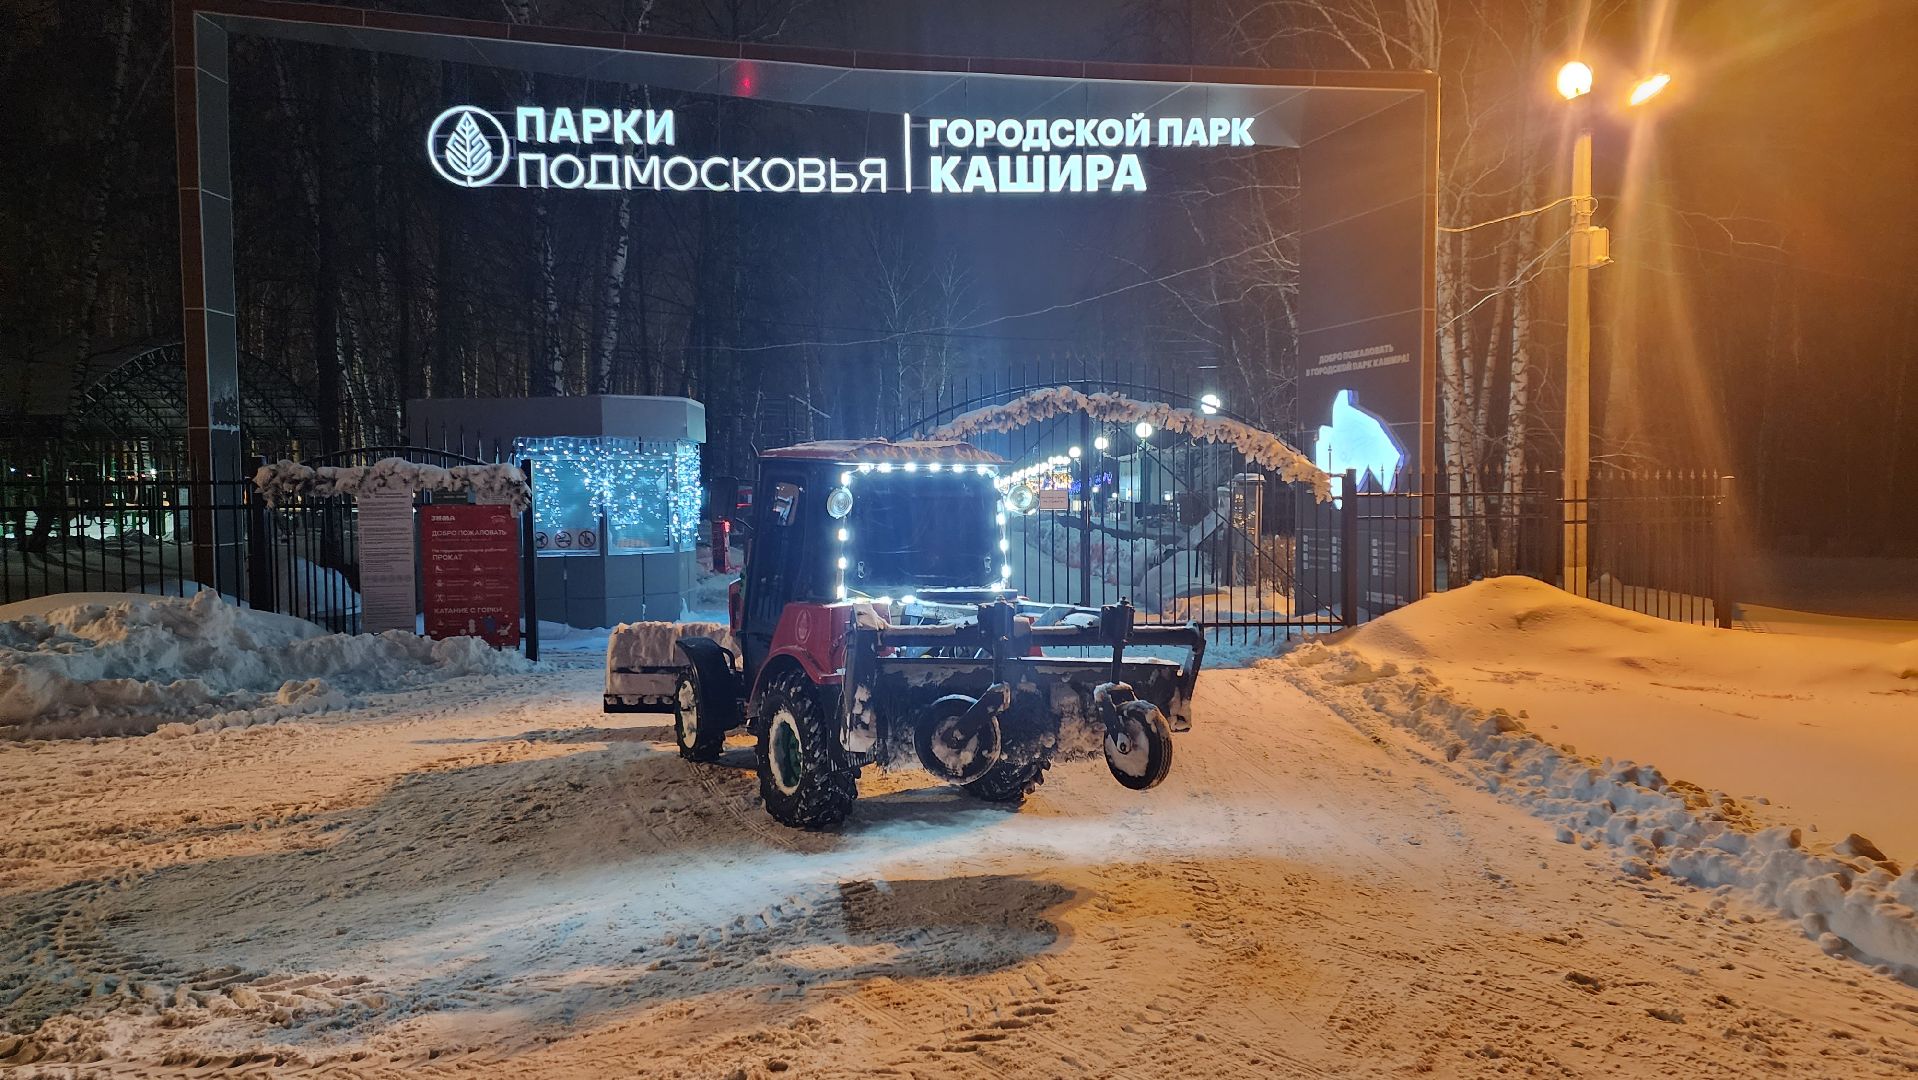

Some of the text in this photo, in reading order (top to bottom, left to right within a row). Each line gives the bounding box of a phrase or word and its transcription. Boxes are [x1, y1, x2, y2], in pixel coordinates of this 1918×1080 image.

[515, 106, 676, 147] ПАРКИ
[929, 112, 1256, 150] ГОРОДСКОЙ ПАРК
[517, 153, 888, 195] ПОДМОСКОВЬЯ
[929, 153, 1148, 194] КАШИРА
[1318, 344, 1394, 365] ДОБРО ПОЖАЛОВАТЬ
[1352, 358, 1373, 371] ПАРК
[458, 529, 508, 537] ПОЖАЛОВАТЬ
[477, 606, 503, 614] ГОРКИ
